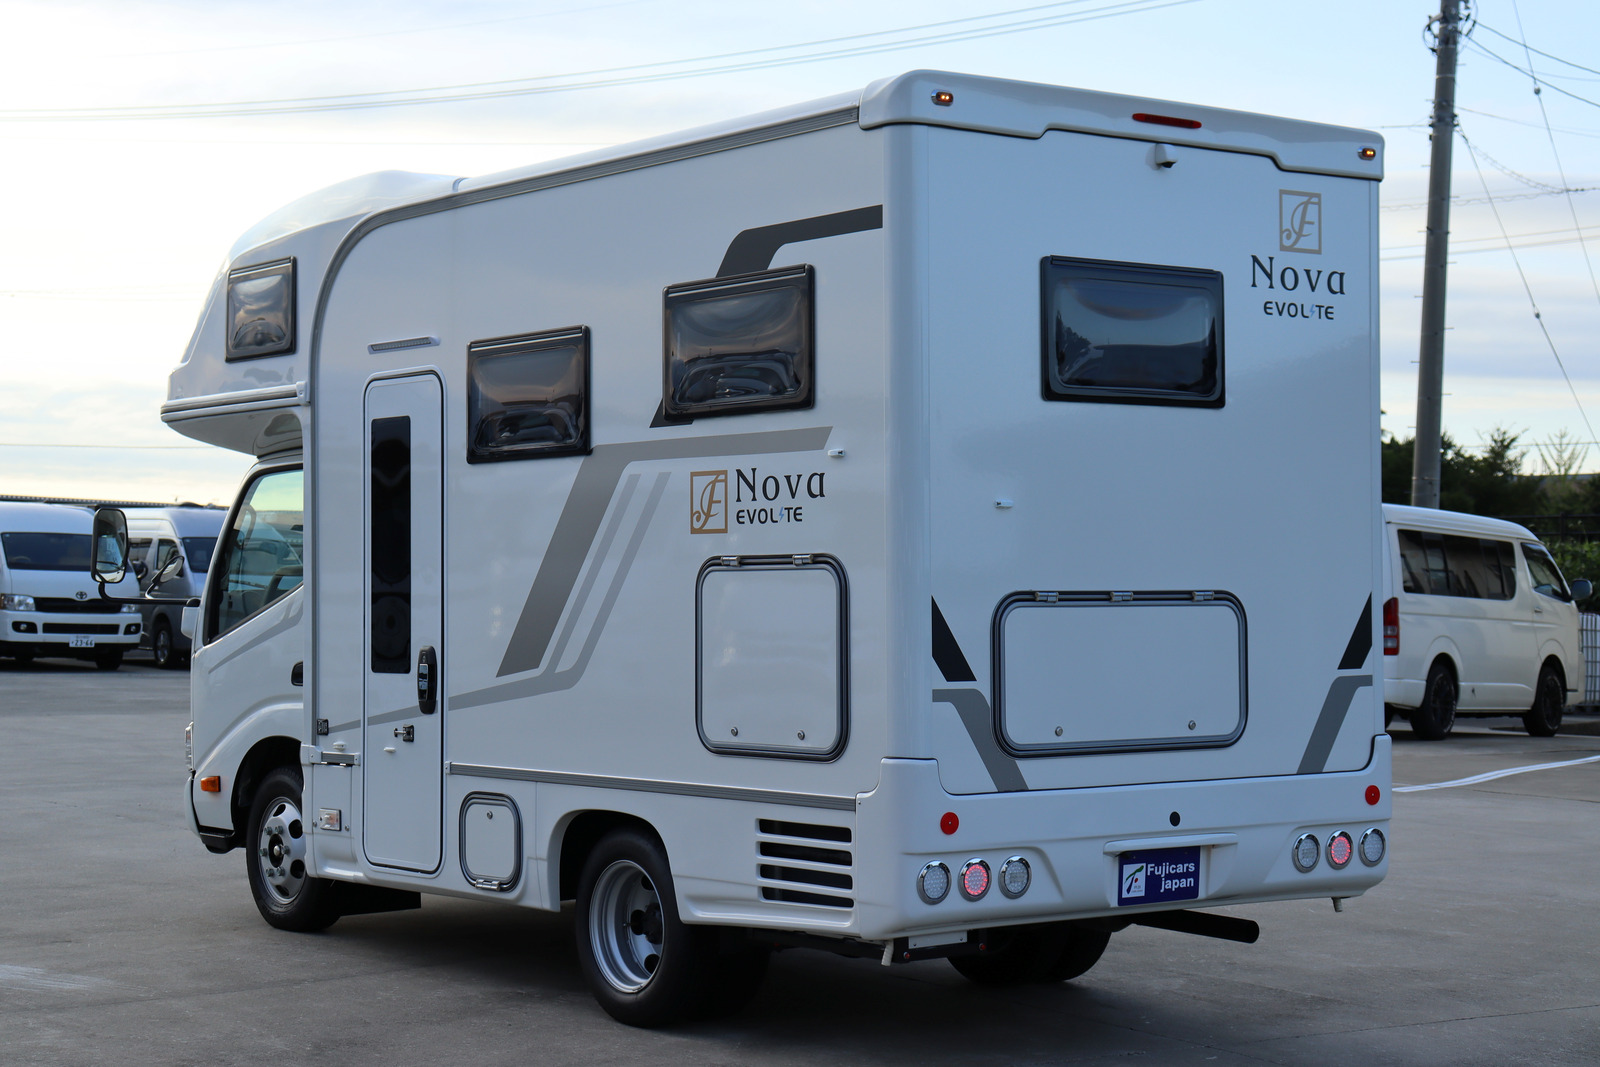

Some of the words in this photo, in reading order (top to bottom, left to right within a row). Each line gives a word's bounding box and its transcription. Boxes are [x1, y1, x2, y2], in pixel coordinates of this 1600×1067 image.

[1251, 254, 1345, 295] Nova
[735, 467, 825, 502] Nova
[1147, 862, 1195, 877] Fujicars
[1160, 878, 1194, 892] japan
